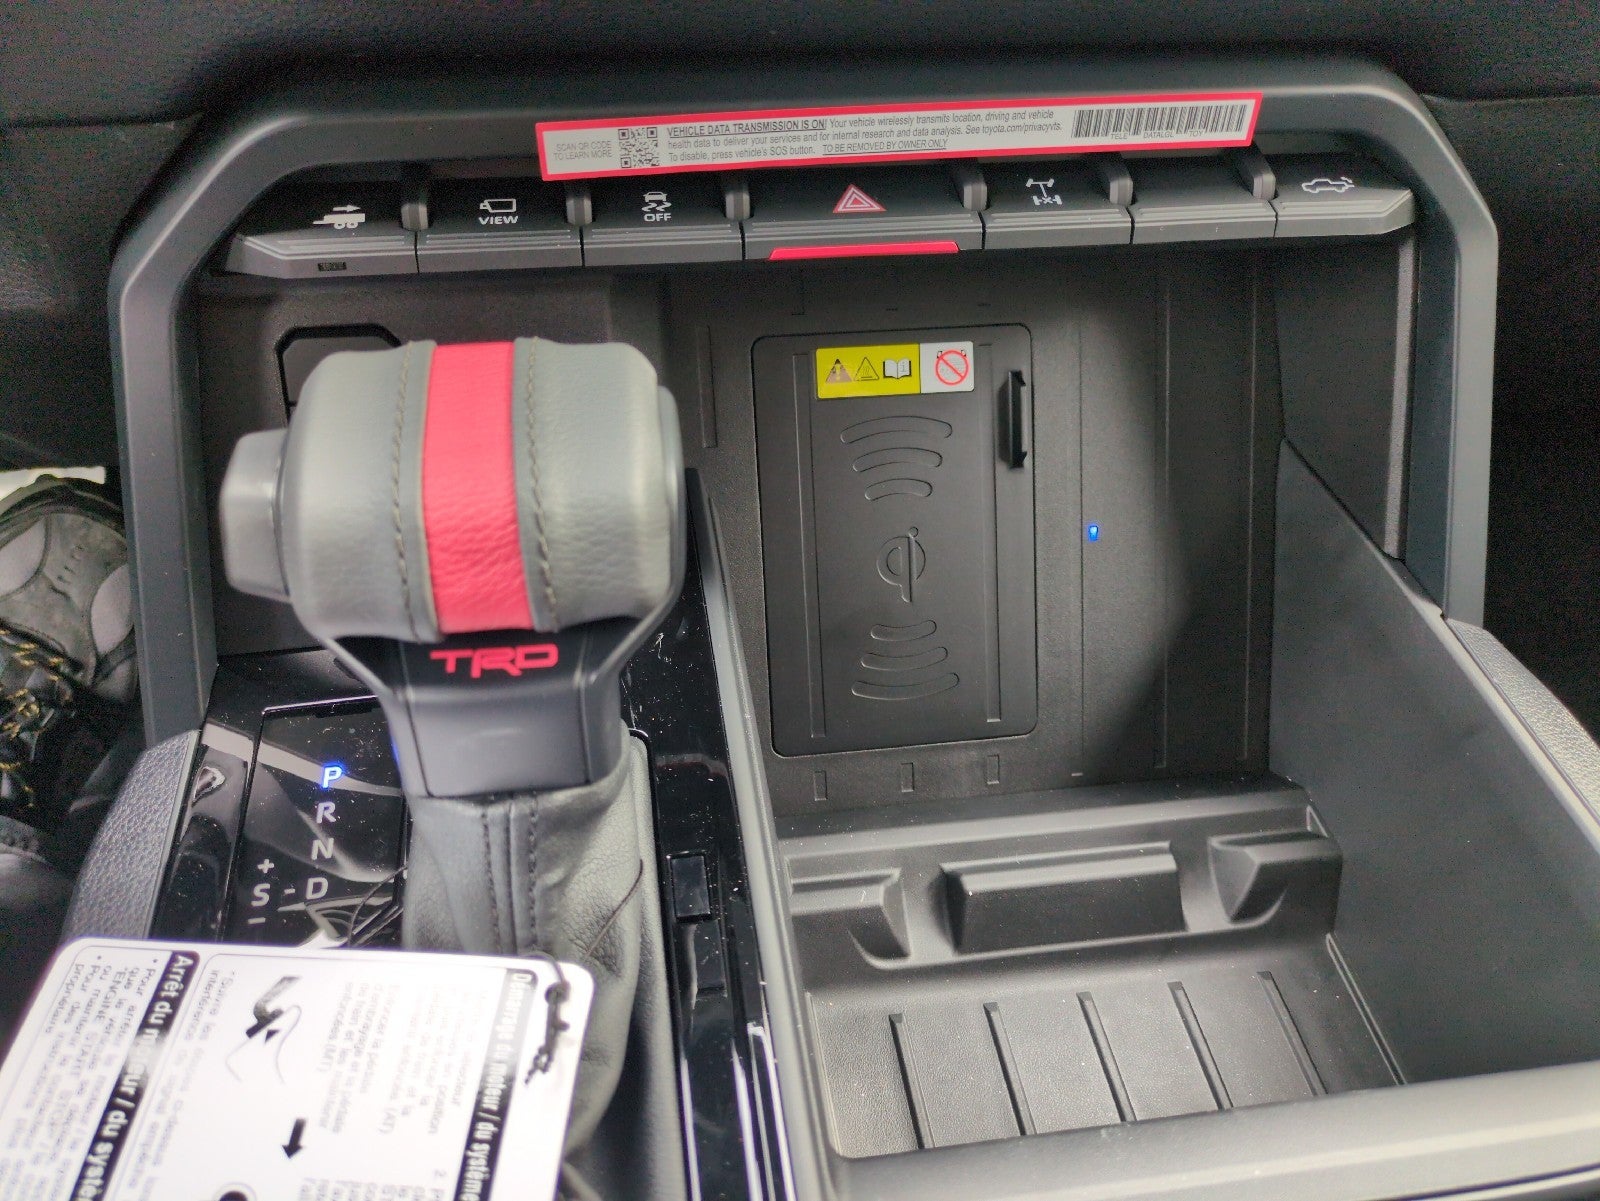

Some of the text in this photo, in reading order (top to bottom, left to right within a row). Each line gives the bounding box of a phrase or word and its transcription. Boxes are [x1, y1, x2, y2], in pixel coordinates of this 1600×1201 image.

[667, 124, 704, 137] VEHICLE
[708, 123, 730, 135] DATA
[733, 119, 799, 133] TRANSMISSION
[801, 118, 810, 129] IS
[811, 118, 827, 129] ON!
[829, 118, 846, 128] Your
[849, 116, 875, 127] vehicle
[878, 115, 913, 128] wirelessly
[916, 113, 950, 124] transmits
[985, 111, 1009, 122] driving
[1011, 110, 1026, 120] and
[1028, 109, 1054, 120] vehicle
[556, 140, 612, 151] SCAN QR CODE
[667, 139, 691, 150] health
[693, 137, 711, 148] data
[713, 137, 721, 147] to
[724, 135, 748, 147] deliver
[751, 136, 767, 147] your
[770, 133, 800, 144] services
[803, 131, 818, 142] and
[820, 131, 830, 140] for
[832, 130, 859, 140] internal
[862, 128, 894, 139] research
[896, 127, 910, 137] and
[913, 126, 928, 136] data
[965, 124, 980, 135] See
[553, 150, 612, 161] TO LEARN MORE
[669, 152, 678, 162] To
[711, 151, 733, 163] press
[735, 147, 767, 159] vehicle's
[770, 146, 788, 156] SOS
[822, 144, 833, 153] TO
[835, 143, 845, 153] BE
[847, 141, 884, 152] REMOVED
[886, 140, 896, 150] BY
[898, 139, 927, 149] OWNER
[928, 138, 948, 148] ONLY
[478, 215, 519, 225] VIEW
[643, 212, 672, 222] OFF
[429, 643, 559, 679] TRD
[322, 766, 343, 789] P
[316, 801, 337, 824] R
[311, 837, 334, 861] N
[251, 883, 271, 907] S
[305, 877, 328, 900] D
[78, 964, 101, 992] Pour
[134, 968, 156, 996] Pour
[158, 955, 194, 998] Arrêt
[148, 1000, 173, 1025] du
[101, 1110, 129, 1138] du
[473, 1121, 499, 1140] du
[74, 1141, 114, 1201] systè
